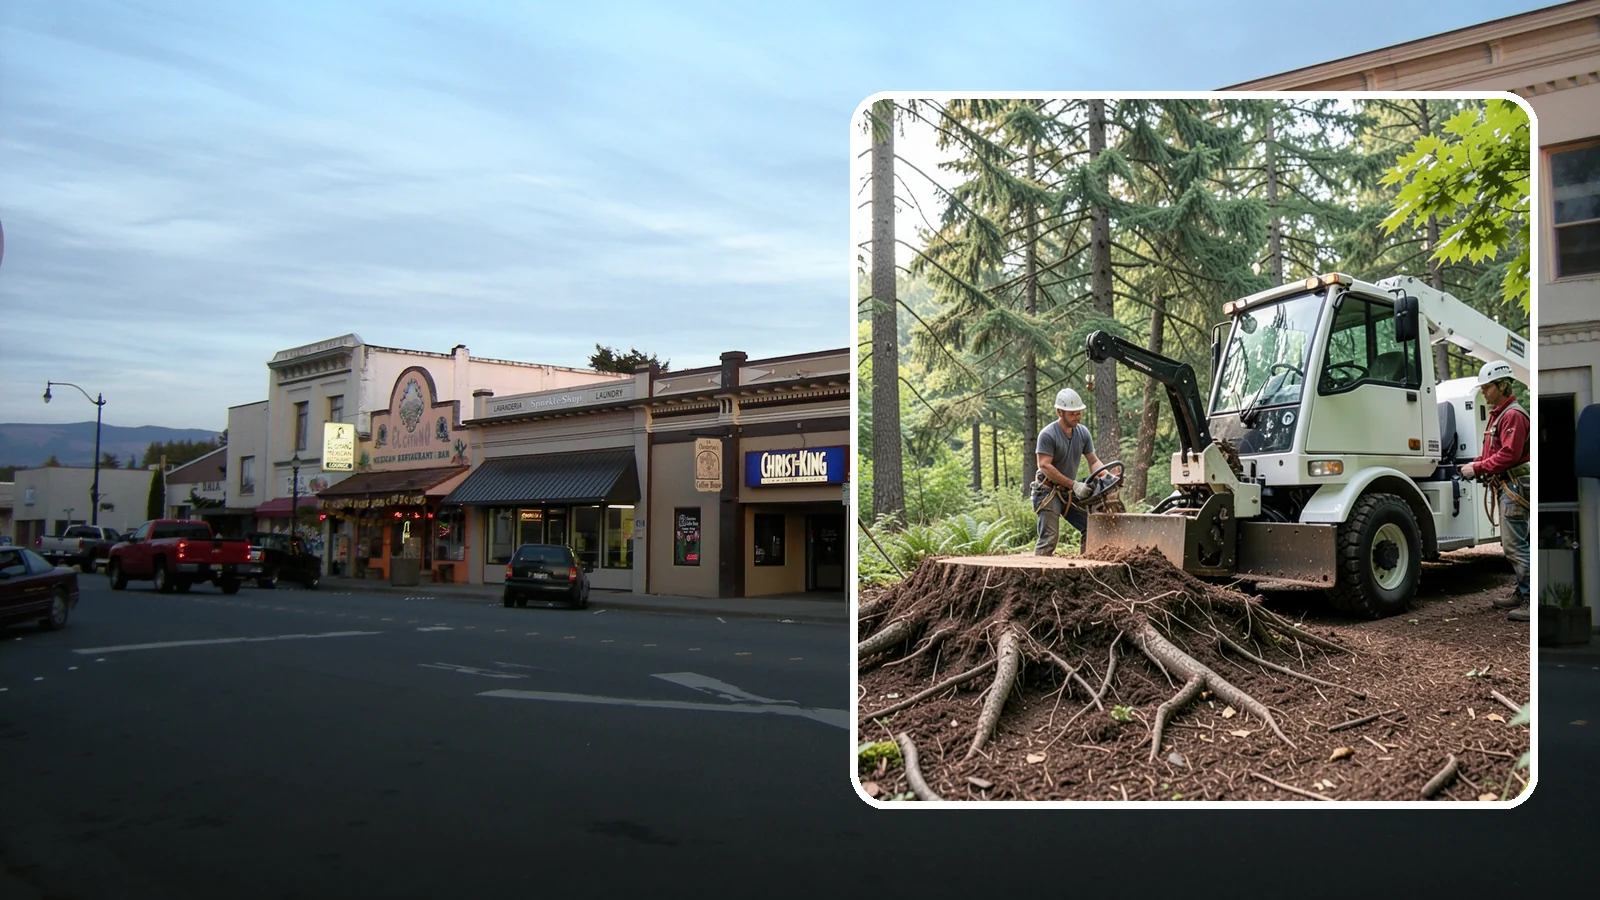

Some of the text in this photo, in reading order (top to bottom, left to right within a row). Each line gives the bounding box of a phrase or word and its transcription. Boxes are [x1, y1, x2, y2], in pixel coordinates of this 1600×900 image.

[595, 389, 623, 400] LAUNDRY
[494, 402, 522, 412] LAVANDERIA
[530, 395, 583, 409] Sparkle Shop
[373, 455, 396, 464] MEXICAN
[397, 451, 433, 463] RESTAURANT
[438, 450, 450, 459] BAR
[760, 450, 828, 478] CHRIST KING
[697, 480, 709, 489] Coffee
